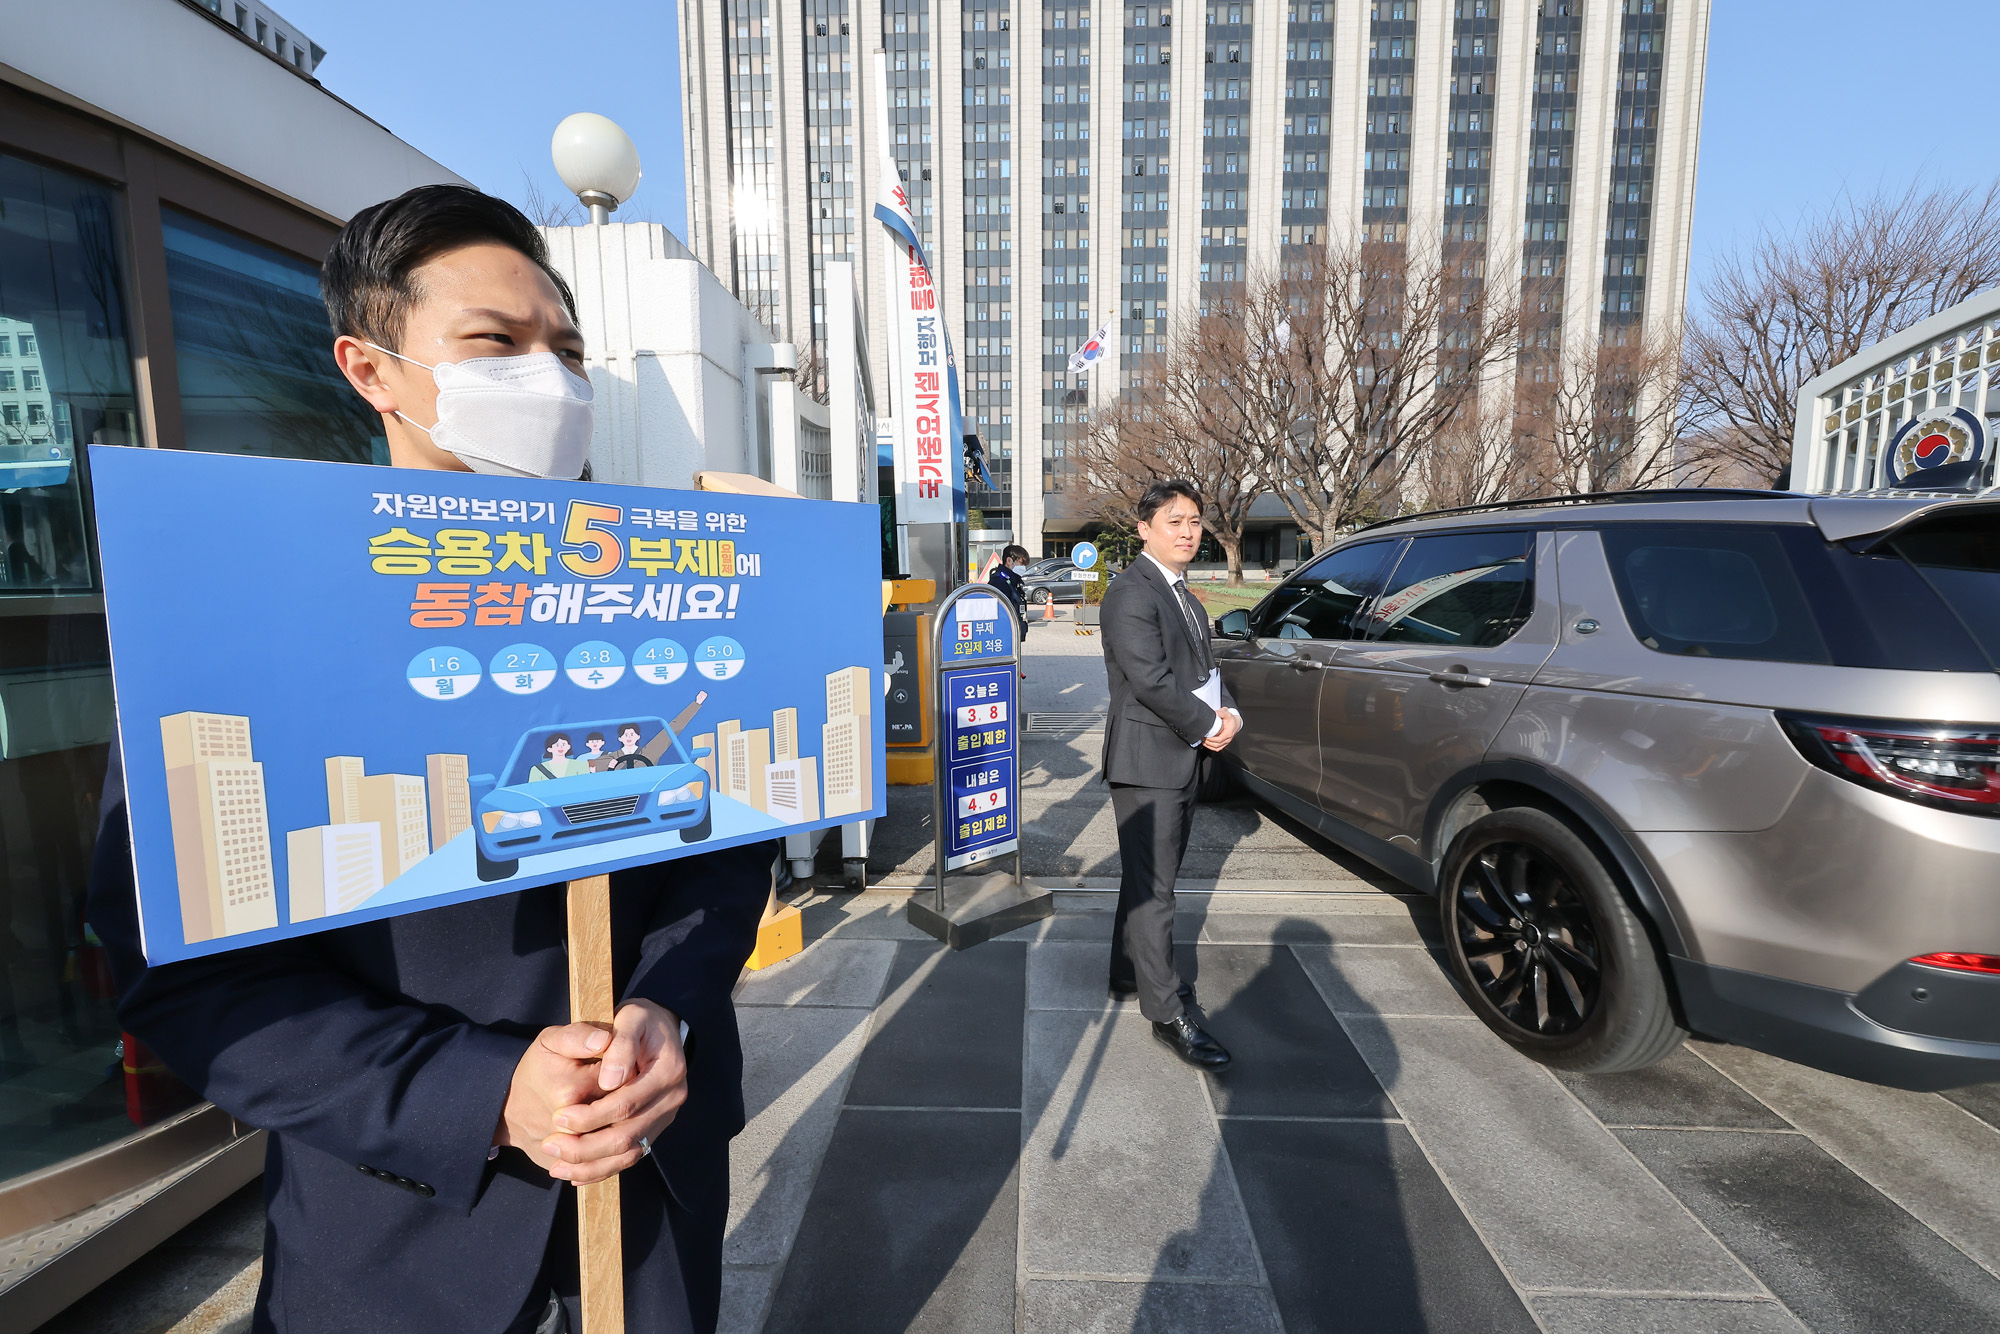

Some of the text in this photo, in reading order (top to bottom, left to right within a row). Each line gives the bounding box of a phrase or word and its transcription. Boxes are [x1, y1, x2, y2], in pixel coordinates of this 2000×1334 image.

[917, 316, 937, 365] 보행자
[914, 372, 943, 498] 국가중요시설
[371, 492, 748, 533] 자원안보위기 극복을 위한
[368, 527, 552, 576] 승용차
[409, 582, 740, 628] 동참해주세요!
[961, 621, 994, 638] 5 부제
[954, 638, 1003, 655] 요일제 적용
[587, 670, 605, 685] 수
[653, 666, 669, 680] 목
[713, 663, 728, 677] 금
[435, 678, 455, 696] 월
[515, 673, 534, 689] 화
[964, 682, 999, 700] 오늘은
[957, 729, 1006, 751] 출입제한
[966, 768, 1000, 788] 내일은
[959, 813, 1007, 840] 출입제한
